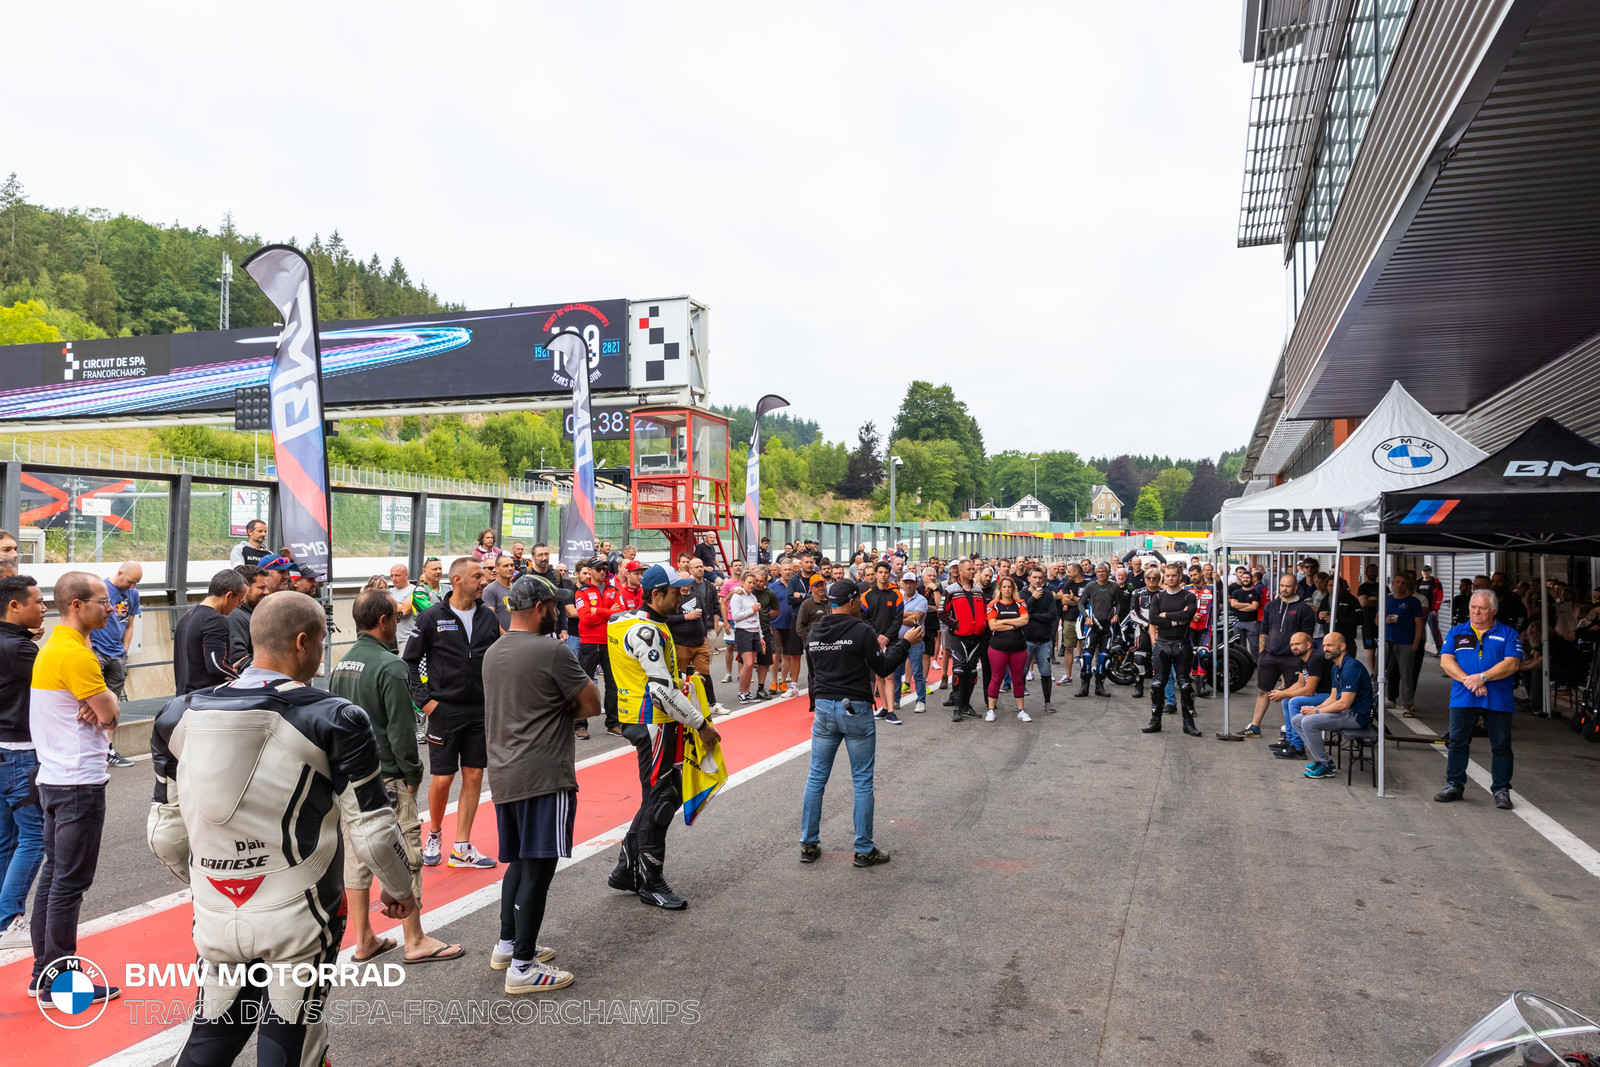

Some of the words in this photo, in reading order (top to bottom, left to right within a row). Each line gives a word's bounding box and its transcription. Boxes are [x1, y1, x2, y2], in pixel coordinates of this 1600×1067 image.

[83, 358, 115, 369] CIRCUIT
[116, 357, 128, 367] DE
[129, 356, 146, 366] SPA
[83, 367, 147, 379] FRANCORCHAMPS
[1381, 438, 1434, 451] BMW
[335, 660, 366, 672] DUCATI
